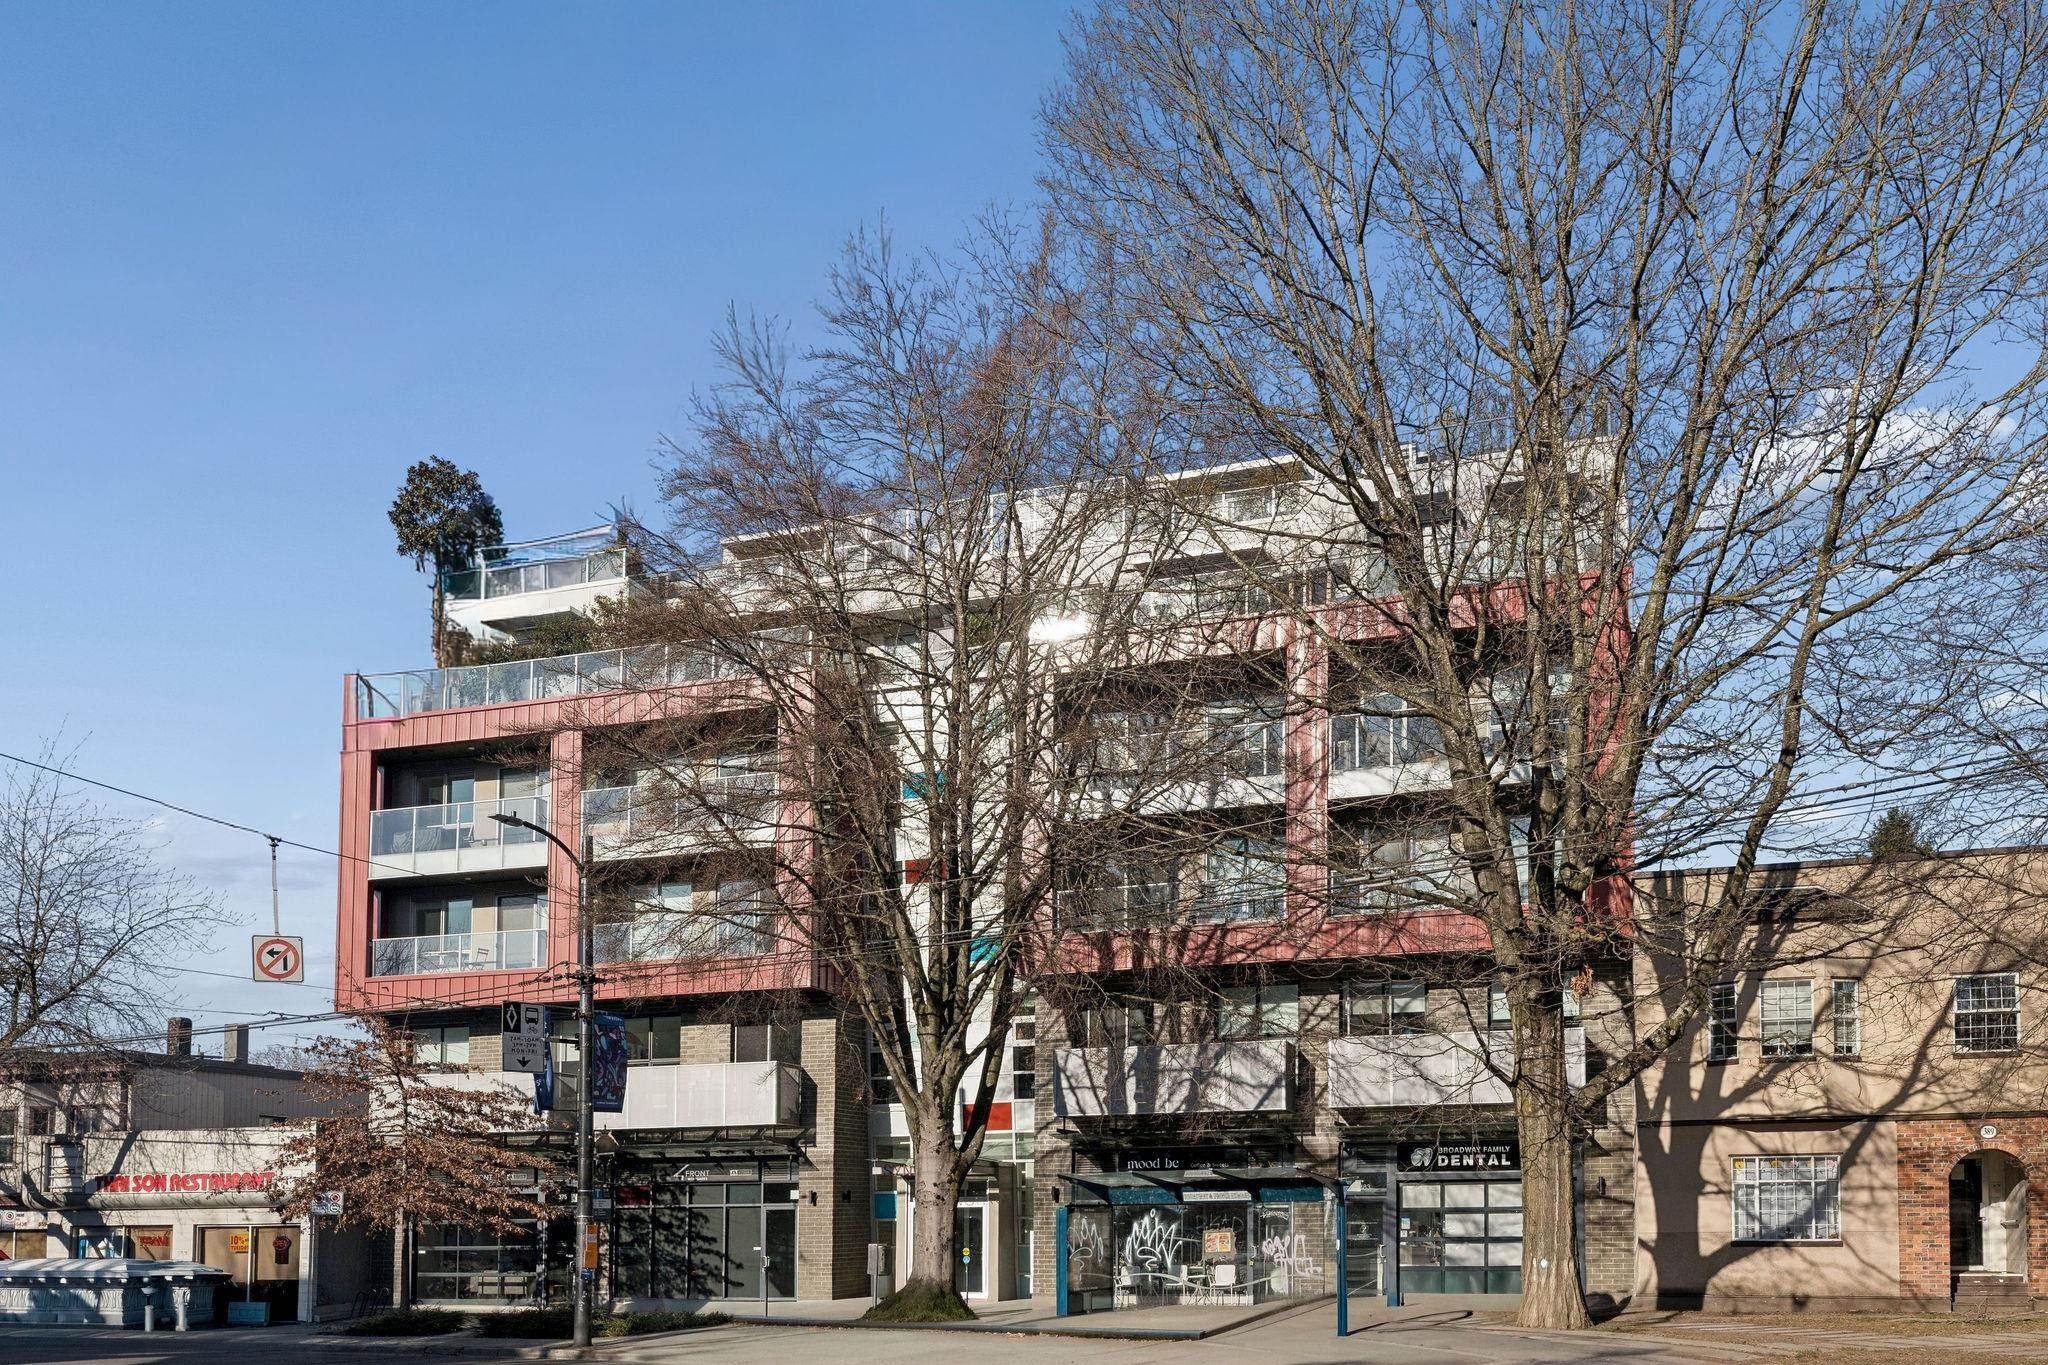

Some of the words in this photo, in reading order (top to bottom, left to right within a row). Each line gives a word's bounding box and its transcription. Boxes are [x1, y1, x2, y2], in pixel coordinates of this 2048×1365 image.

[1983, 1127, 1994, 1135] 389
[1438, 1146, 1481, 1154] BROADWAY
[1483, 1145, 1511, 1153] FAMILY
[1127, 1158, 1160, 1169] mood
[1165, 1158, 1180, 1169] be
[1438, 1153, 1511, 1166] DENTAL
[132, 1173, 167, 1192] SON
[169, 1171, 276, 1192] RESTAURANT
